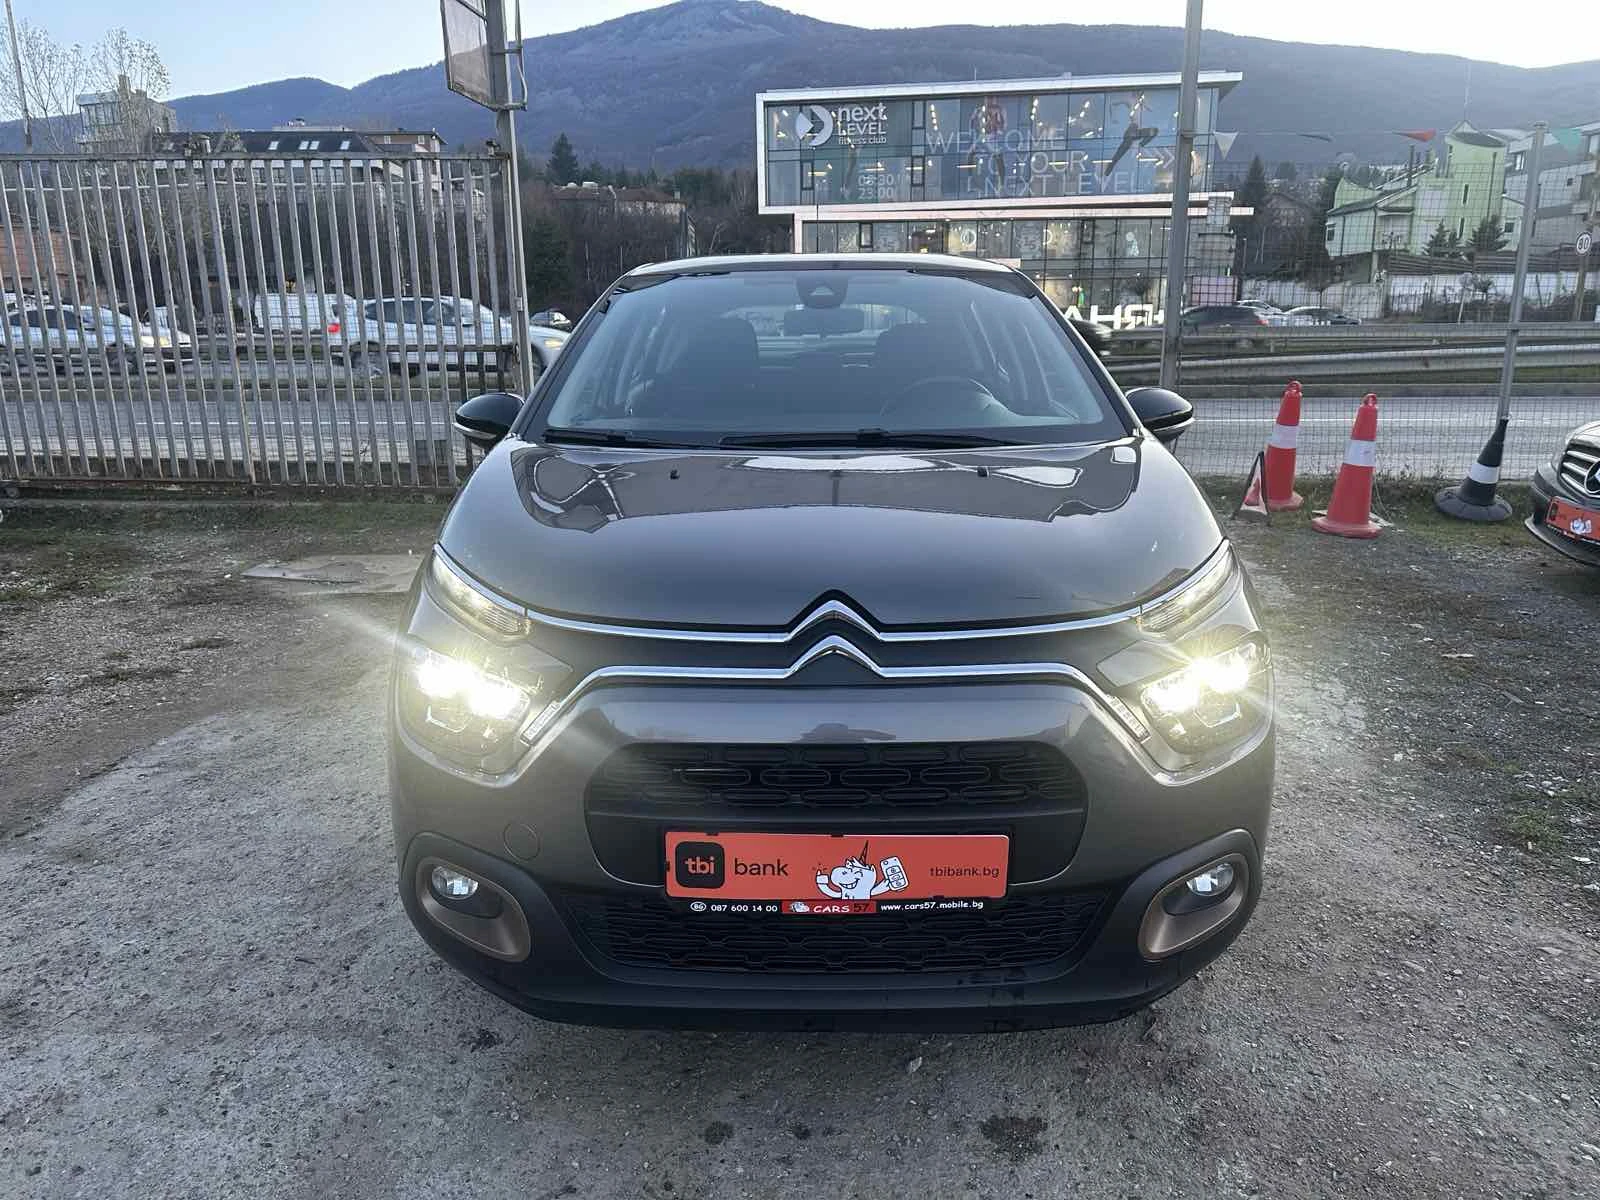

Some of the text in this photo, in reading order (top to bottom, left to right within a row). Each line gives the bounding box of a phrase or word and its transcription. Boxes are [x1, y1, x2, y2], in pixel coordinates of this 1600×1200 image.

[838, 103, 887, 122] next
[838, 122, 887, 136] LEVEL
[869, 136, 887, 145] club
[925, 128, 1066, 154] WELCOME
[1012, 150, 1086, 175] YOUR
[984, 171, 1145, 198] NEXT LEVEL
[684, 855, 789, 876] tbi bank
[930, 866, 1000, 878] tbibank.bg
[813, 903, 870, 913] CARS 57
[881, 901, 984, 912] www.cars57.mobile.bg
